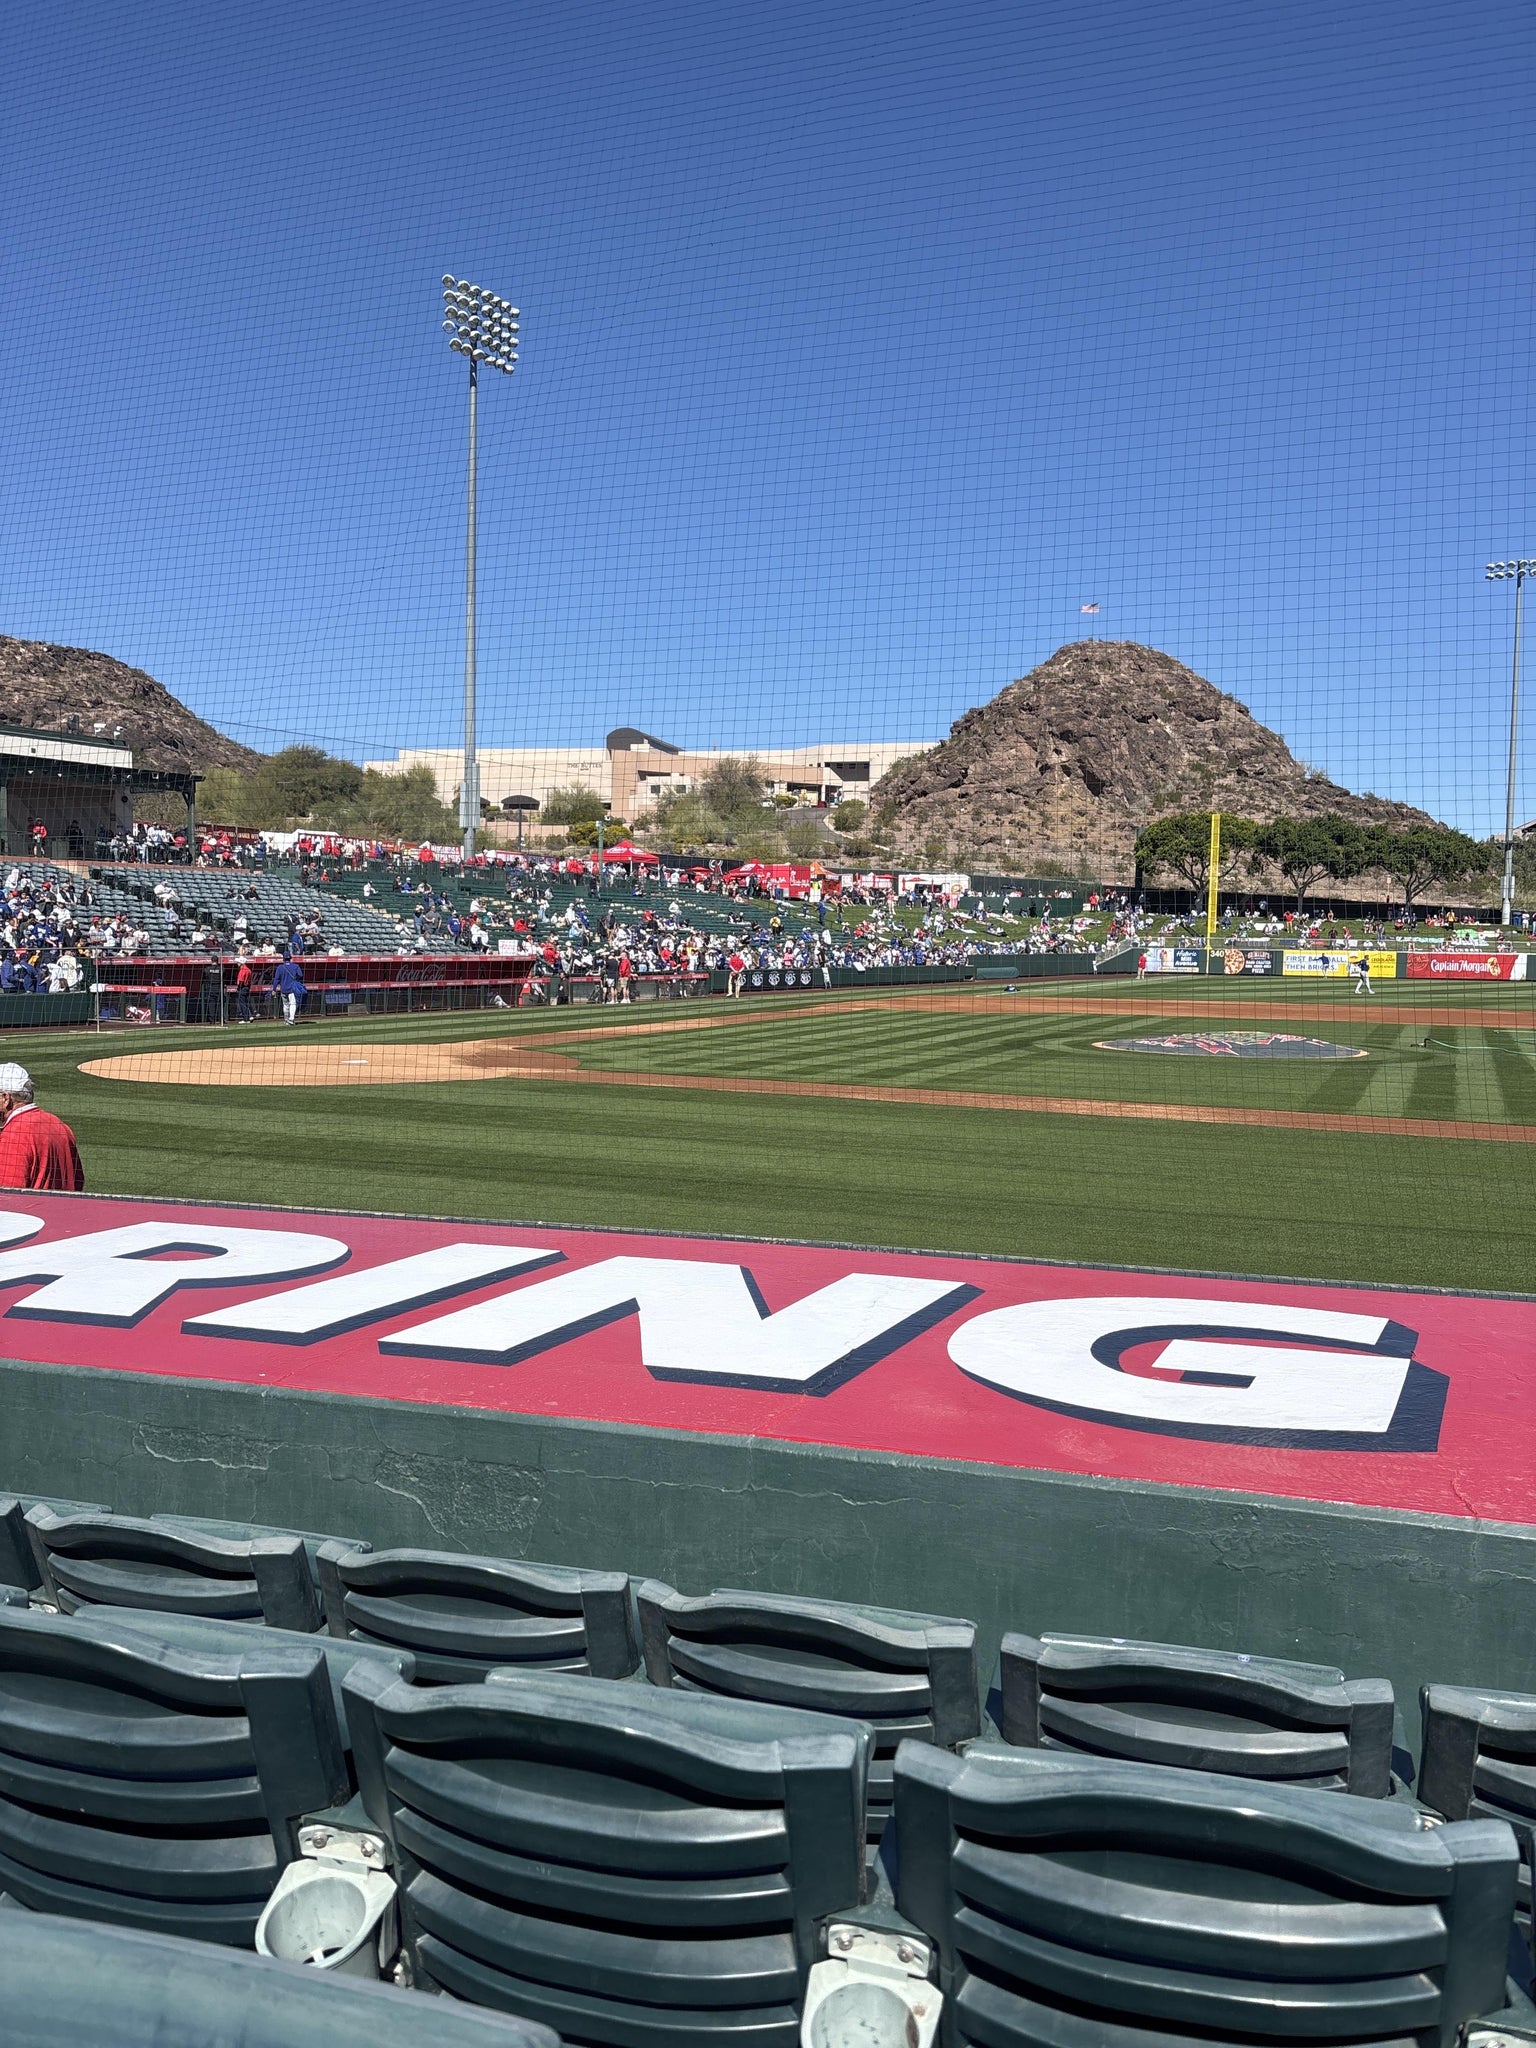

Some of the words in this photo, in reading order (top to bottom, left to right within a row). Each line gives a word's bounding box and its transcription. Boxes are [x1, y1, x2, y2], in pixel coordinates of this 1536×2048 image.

[1210, 950, 1224, 958] 340
[1430, 959, 1459, 973] Captain
[1458, 960, 1489, 974] Morgan
[0, 1209, 1451, 1453] RING
